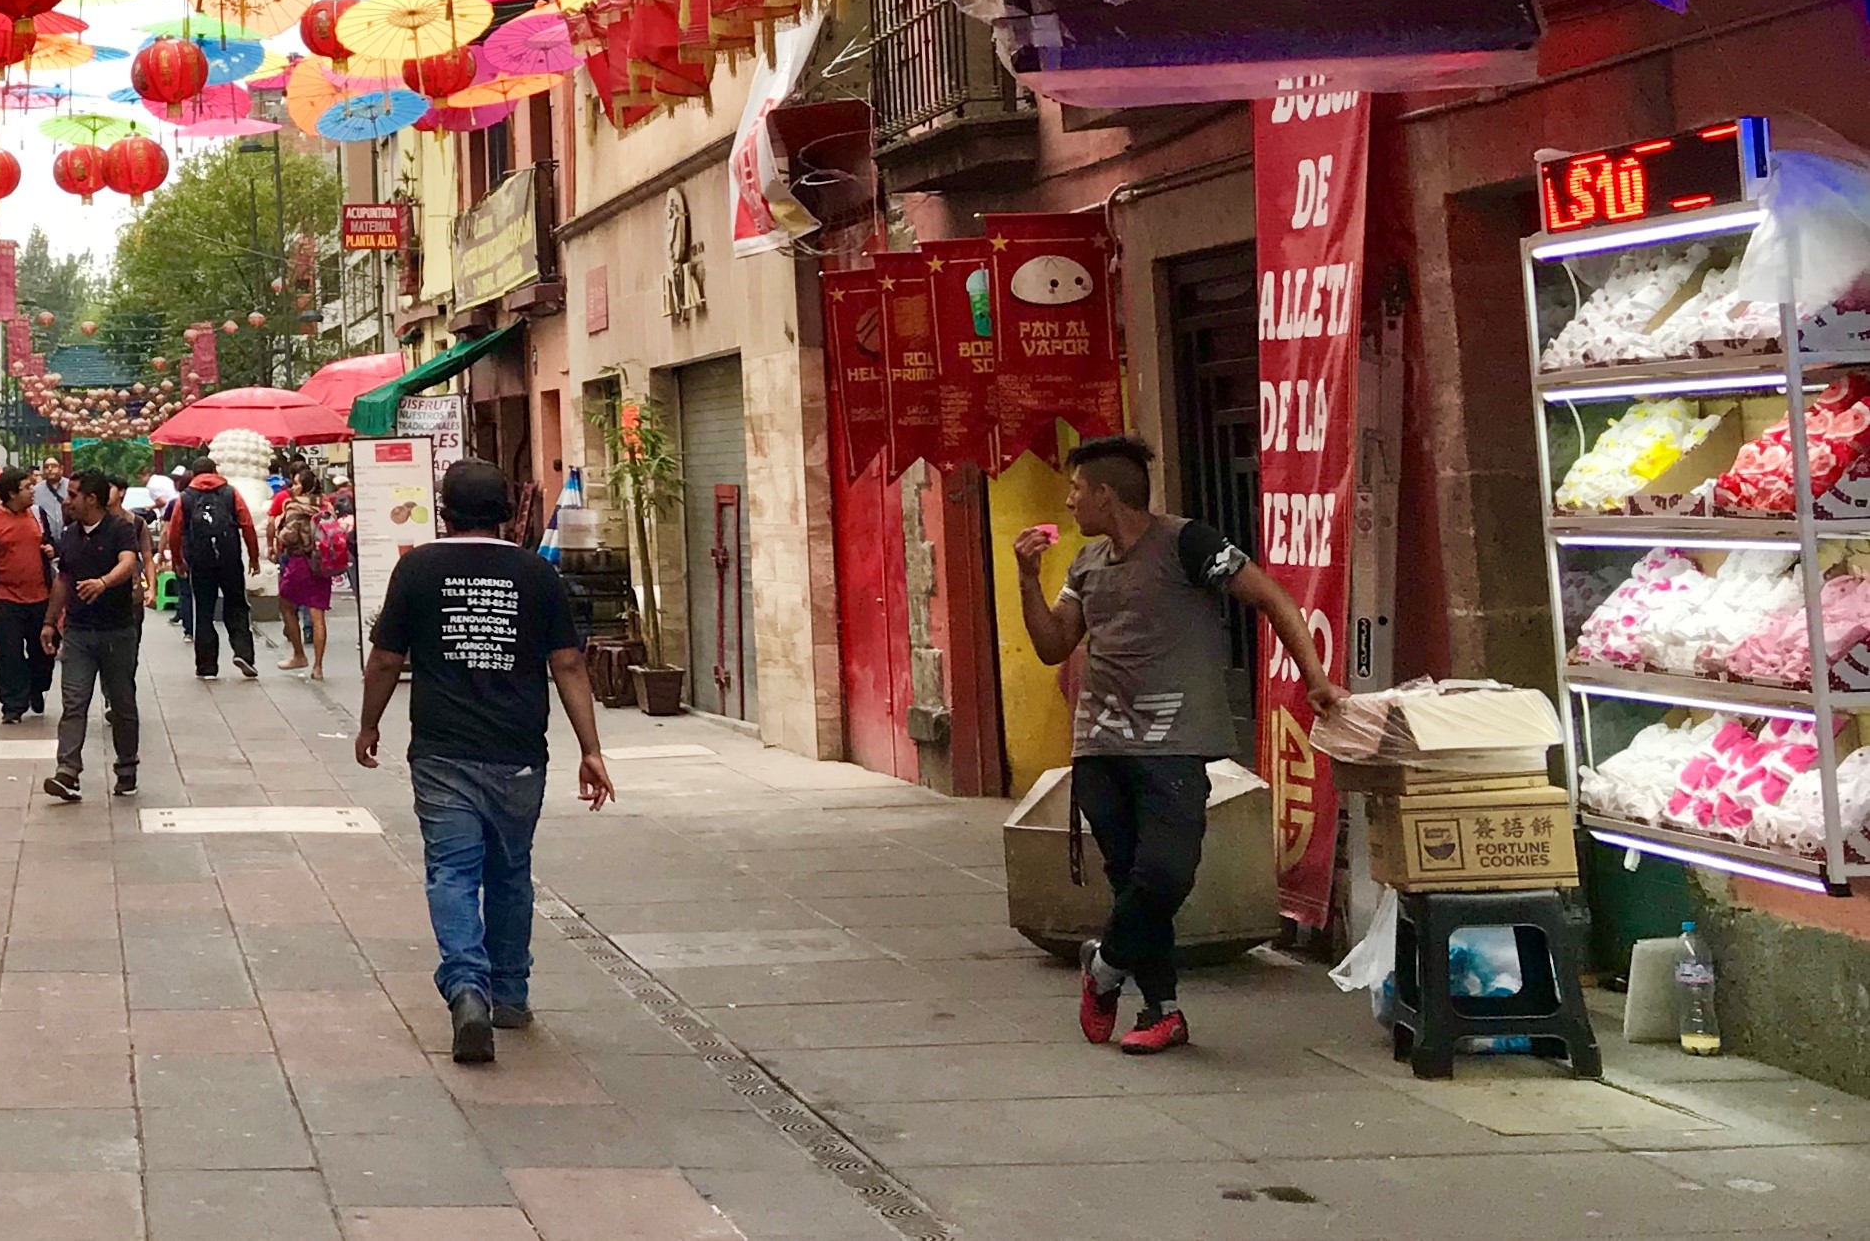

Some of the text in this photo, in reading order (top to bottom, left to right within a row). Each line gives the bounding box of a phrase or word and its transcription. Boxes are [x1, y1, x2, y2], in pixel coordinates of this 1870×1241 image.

[1291, 154, 1333, 230] DE
[345, 234, 398, 247] PLANTA ALTA
[1018, 319, 1091, 338] PAN AL
[1021, 338, 1091, 356] VAPOR
[398, 398, 458, 410] DISFRUTE
[399, 410, 458, 420] NUESTROS YA
[1260, 378, 1329, 452] DE LA
[399, 420, 461, 432] TRADICIONALES
[444, 577, 514, 589] SAN LORENZO
[449, 615, 510, 626] RENOVACION
[455, 641, 503, 652] AGRICOLA
[1475, 841, 1551, 855] FORTUNE
[1480, 854, 1551, 868] COOKIES
